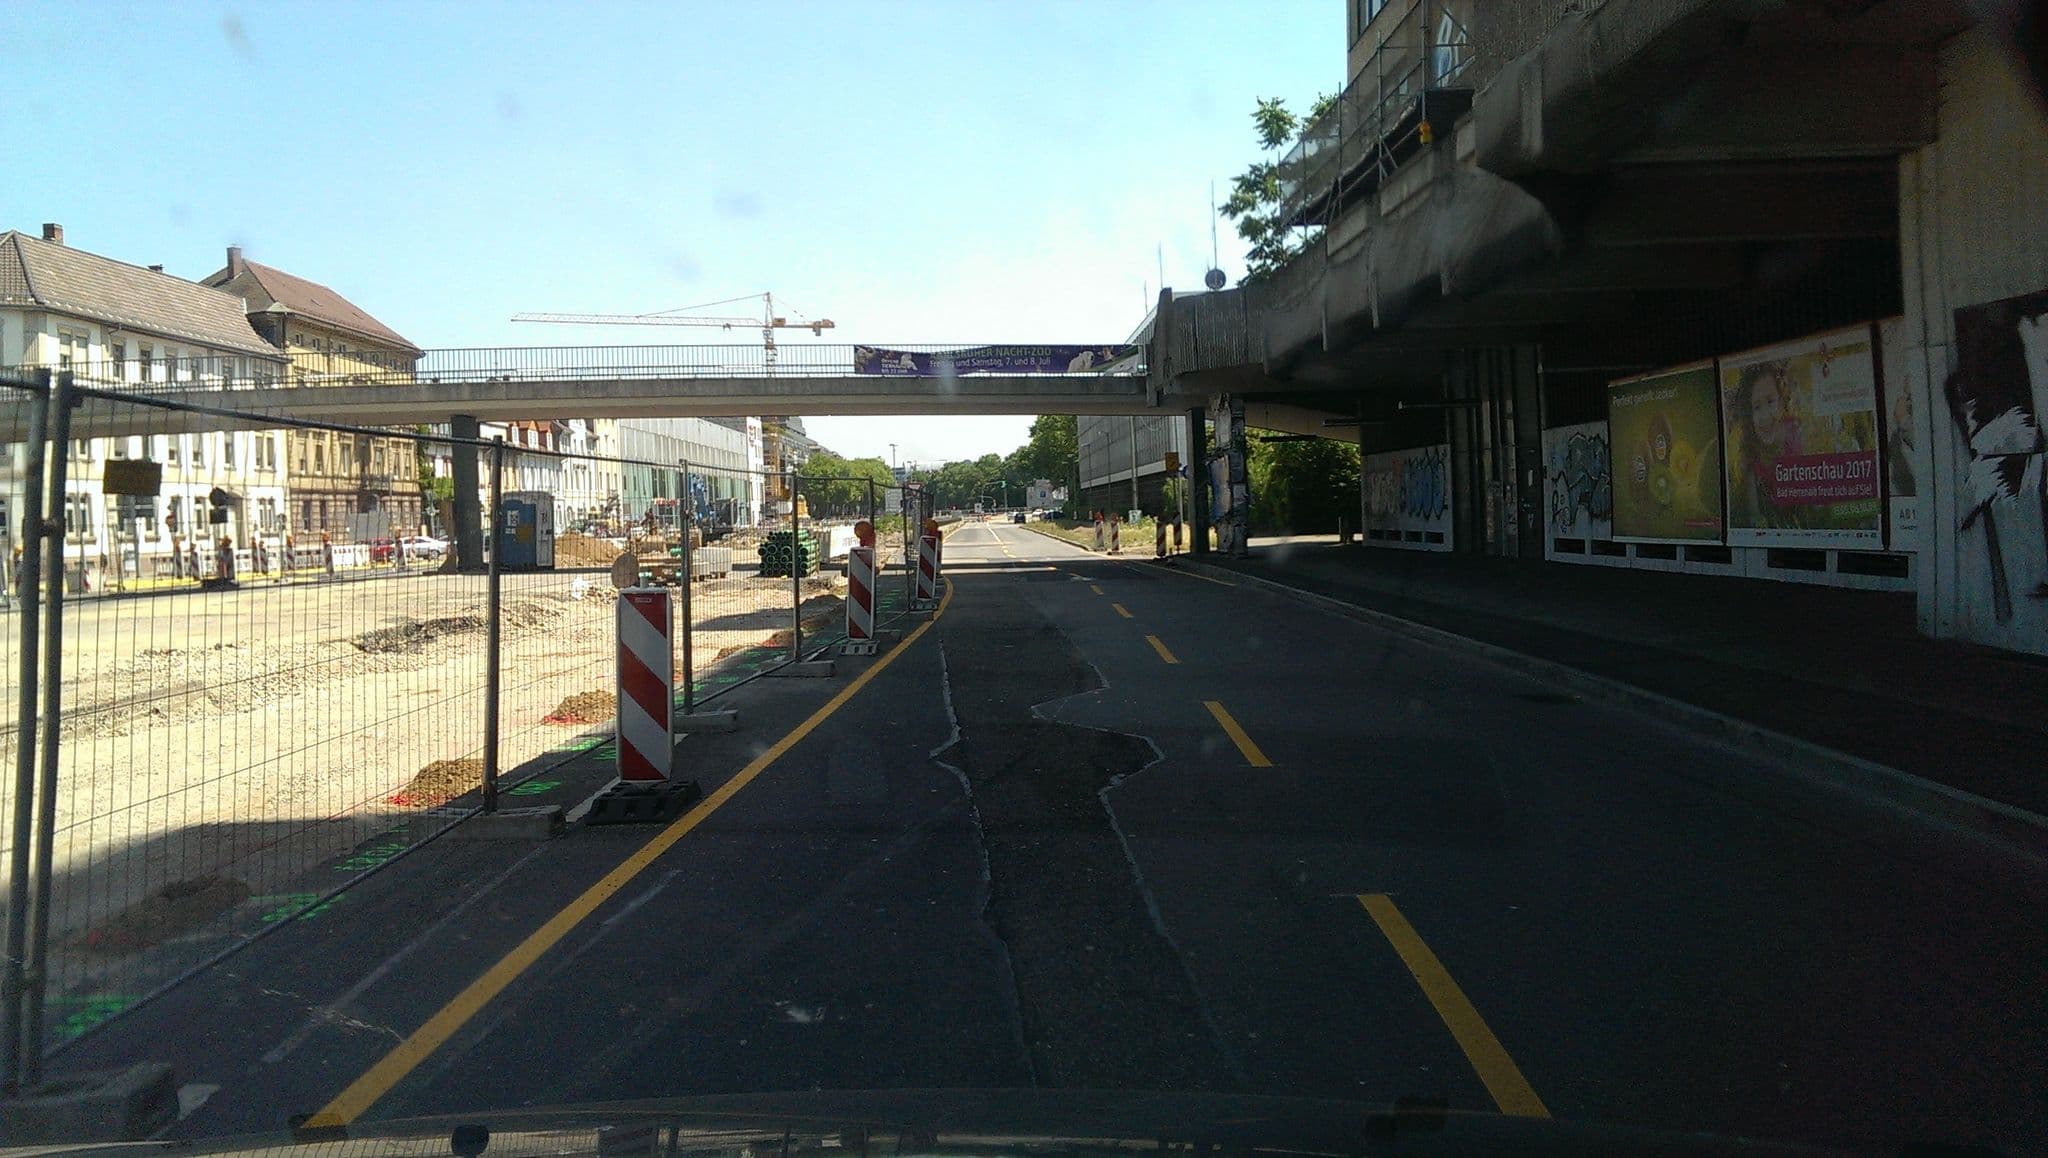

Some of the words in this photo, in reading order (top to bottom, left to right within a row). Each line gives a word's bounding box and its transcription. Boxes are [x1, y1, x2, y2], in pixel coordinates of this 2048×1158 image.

[996, 346, 1052, 358] NACHT-ZOO
[1775, 460, 1844, 482] Gartenschau
[1845, 459, 1872, 479] 2017
